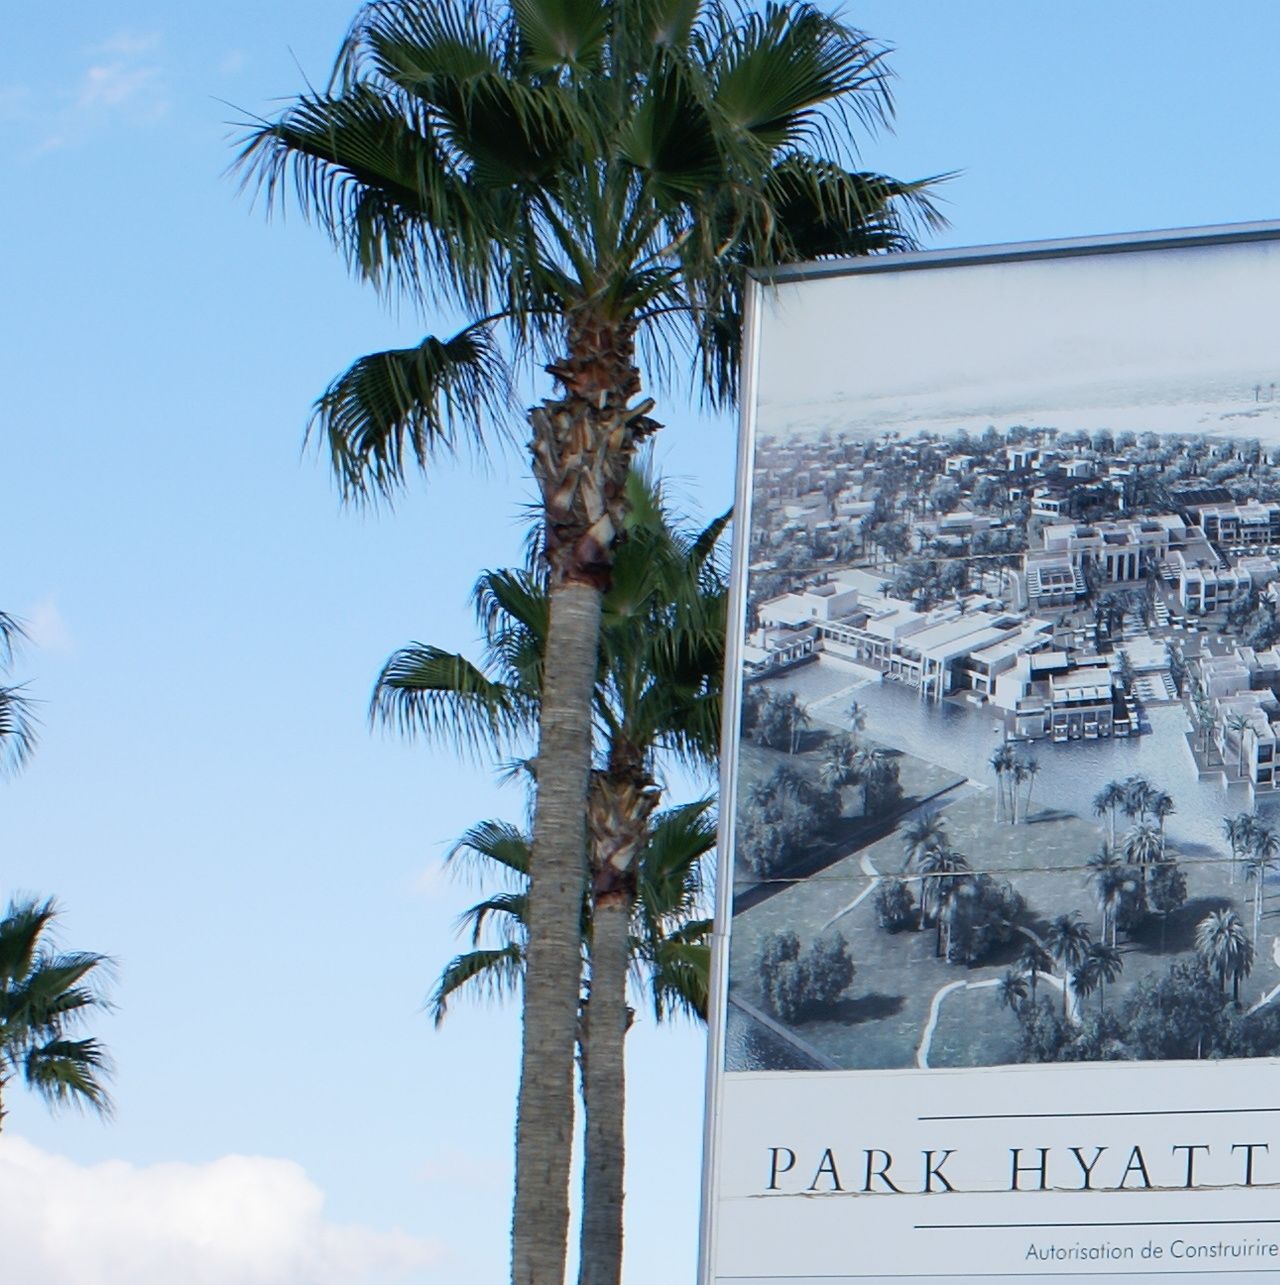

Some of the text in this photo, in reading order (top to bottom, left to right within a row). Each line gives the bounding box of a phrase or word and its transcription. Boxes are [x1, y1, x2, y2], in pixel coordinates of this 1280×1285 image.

[765, 1146, 961, 1192] PARK
[1008, 1143, 1270, 1191] HYATT
[1025, 1241, 1135, 1261] Autorisation
[1139, 1240, 1163, 1259] de
[1170, 1237, 1280, 1259] Construirire
